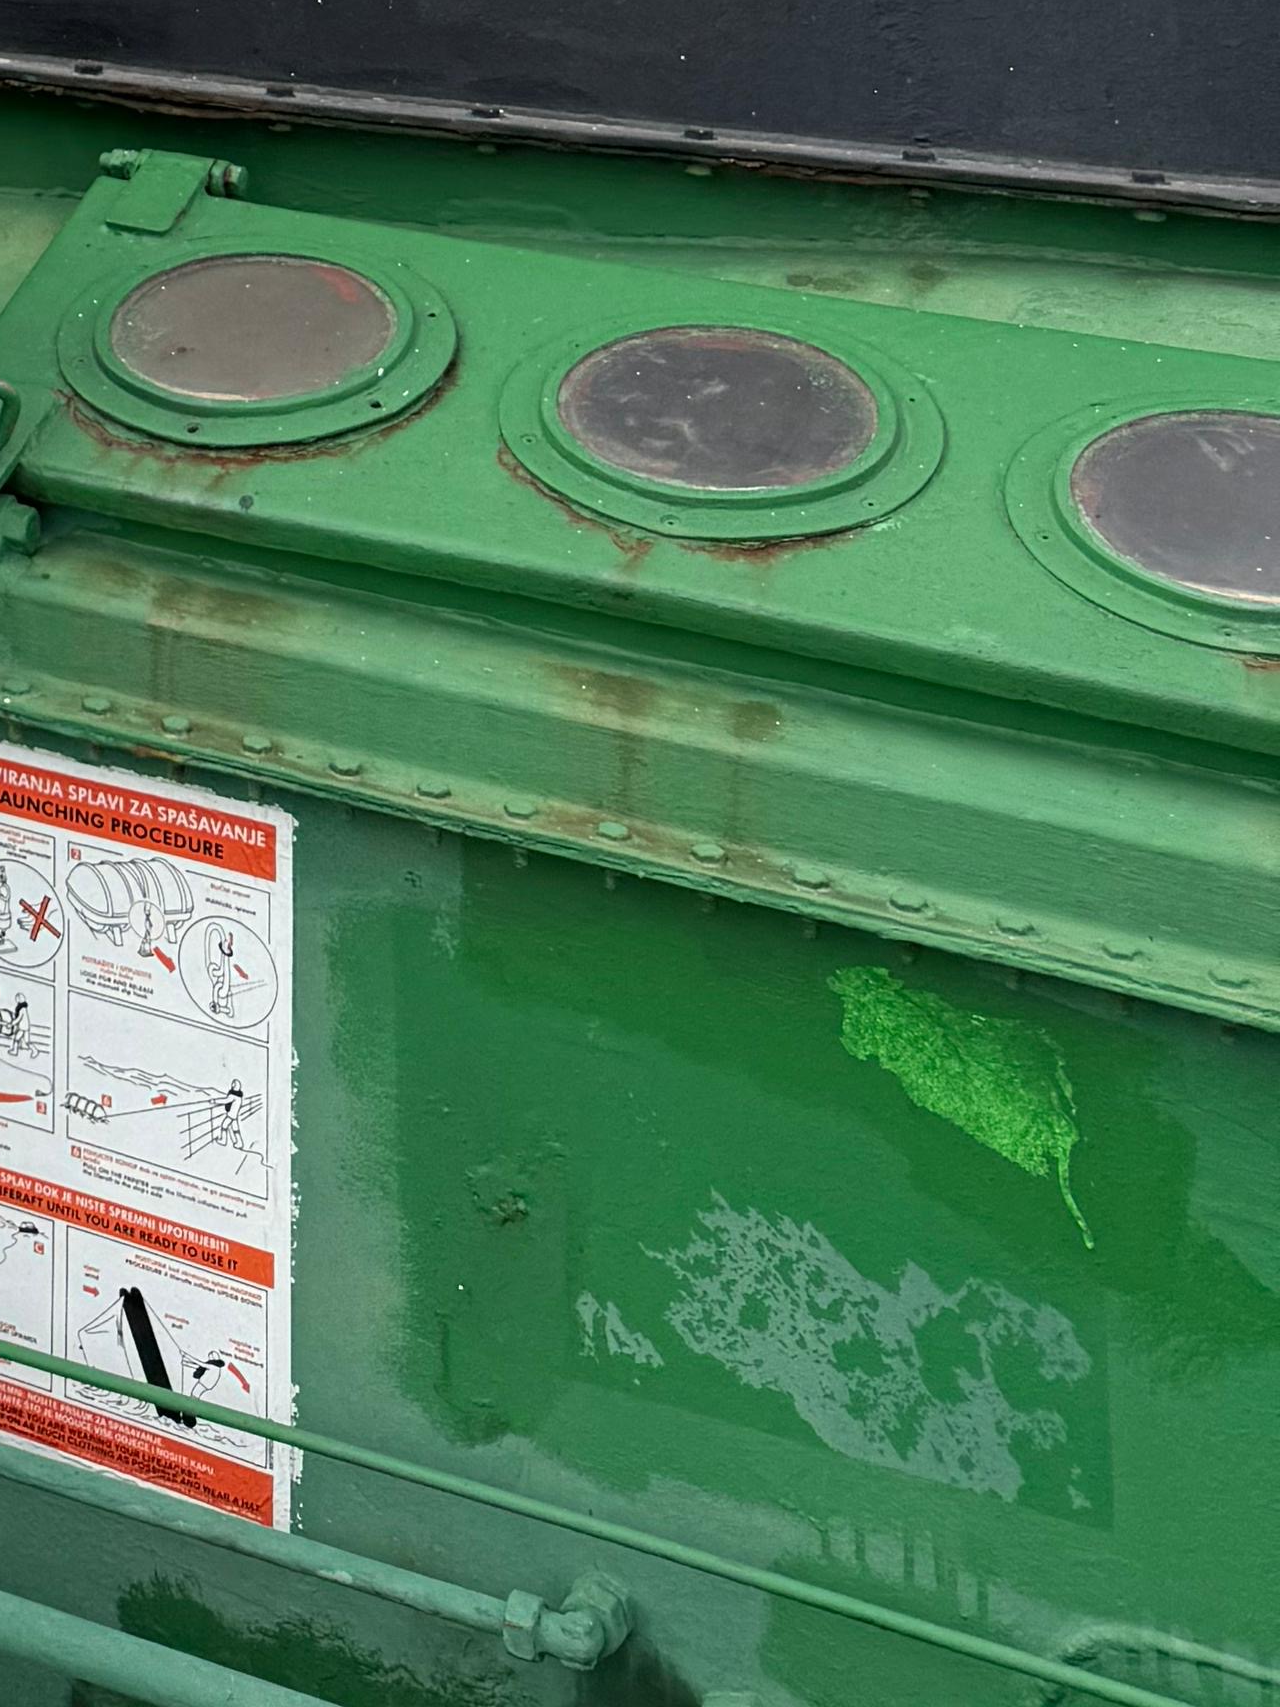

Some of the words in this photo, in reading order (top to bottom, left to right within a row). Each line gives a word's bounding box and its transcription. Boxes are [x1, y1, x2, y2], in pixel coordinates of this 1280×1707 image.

[68, 783, 123, 812] SPLAVI
[129, 798, 153, 819] ZA
[157, 805, 265, 847] SPAŠAVANJE
[111, 816, 223, 859] PROCEDURE
[0, 1170, 31, 1191] SPLAV
[34, 1181, 59, 1199] DOK
[62, 1189, 72, 1204] JE
[75, 1194, 105, 1215] NISTE
[108, 1204, 155, 1231] SPREMNI
[46, 1199, 80, 1221] UNTIL
[84, 1210, 109, 1230] YOU
[113, 1220, 135, 1238] ARE
[139, 1228, 177, 1251] READY
[180, 1242, 198, 1258] TO
[201, 1249, 223, 1267] USE
[227, 1257, 237, 1271] IT
